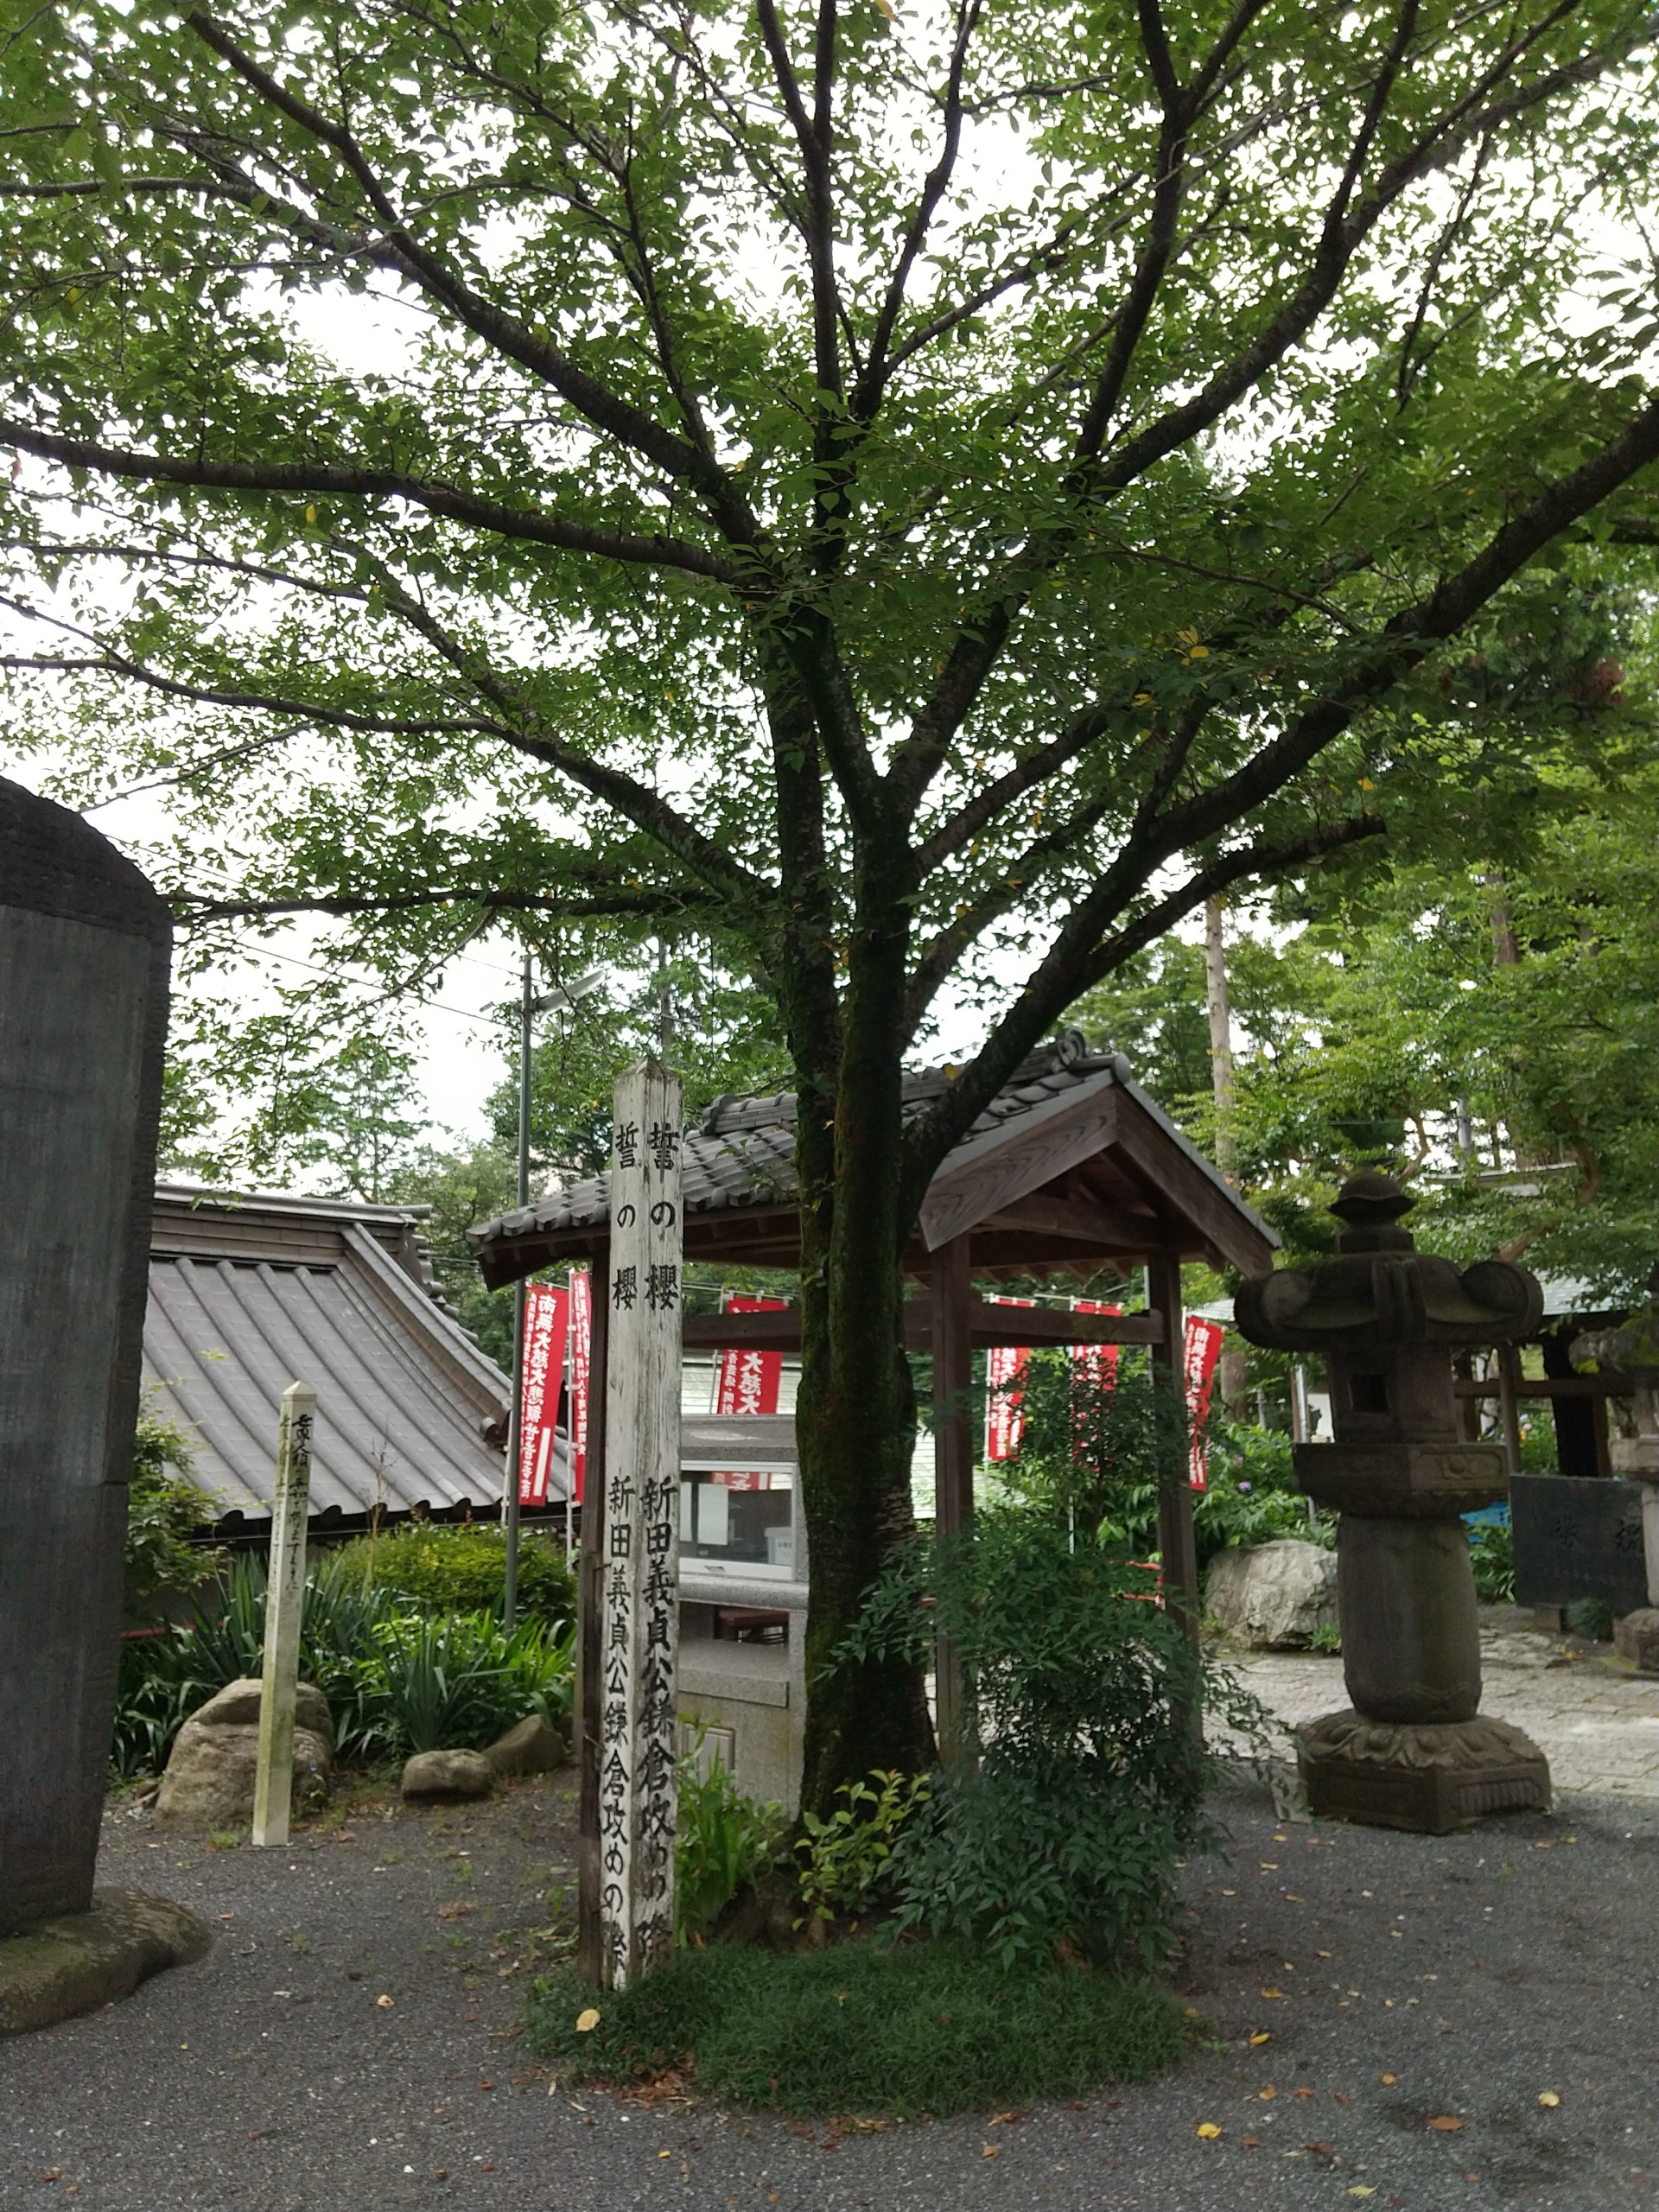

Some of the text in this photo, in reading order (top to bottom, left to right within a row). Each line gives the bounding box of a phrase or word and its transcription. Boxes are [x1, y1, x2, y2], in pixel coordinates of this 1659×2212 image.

[612, 1121, 639, 1311] 誓の櫻
[645, 1122, 681, 1311] 誓の櫻
